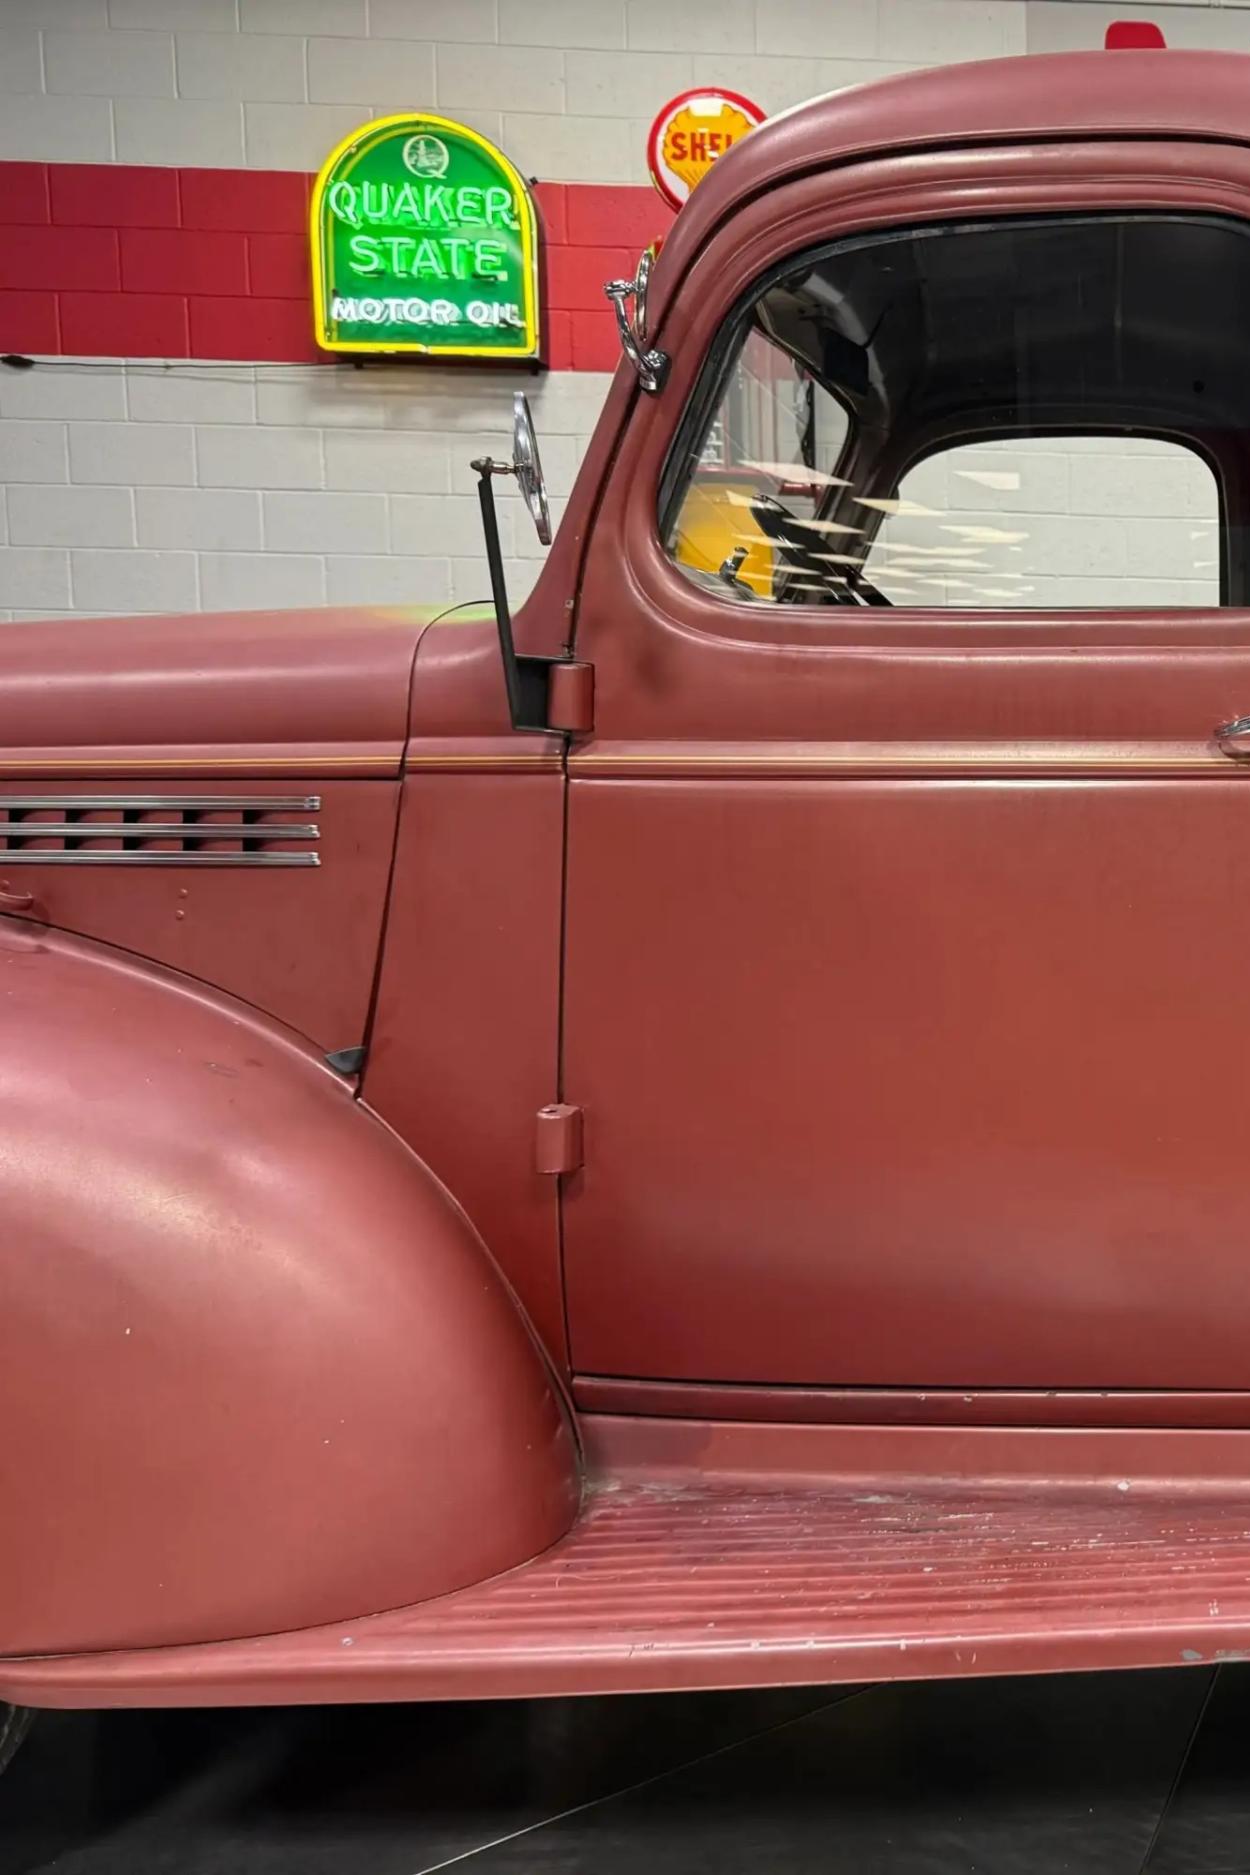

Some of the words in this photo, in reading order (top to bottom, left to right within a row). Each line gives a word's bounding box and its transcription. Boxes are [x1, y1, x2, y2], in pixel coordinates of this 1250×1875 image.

[671, 131, 733, 162] SHE
[328, 180, 520, 229] QUAKER
[349, 235, 508, 281] STATE
[331, 297, 462, 326] MOTOR
[465, 301, 527, 328] OIL
